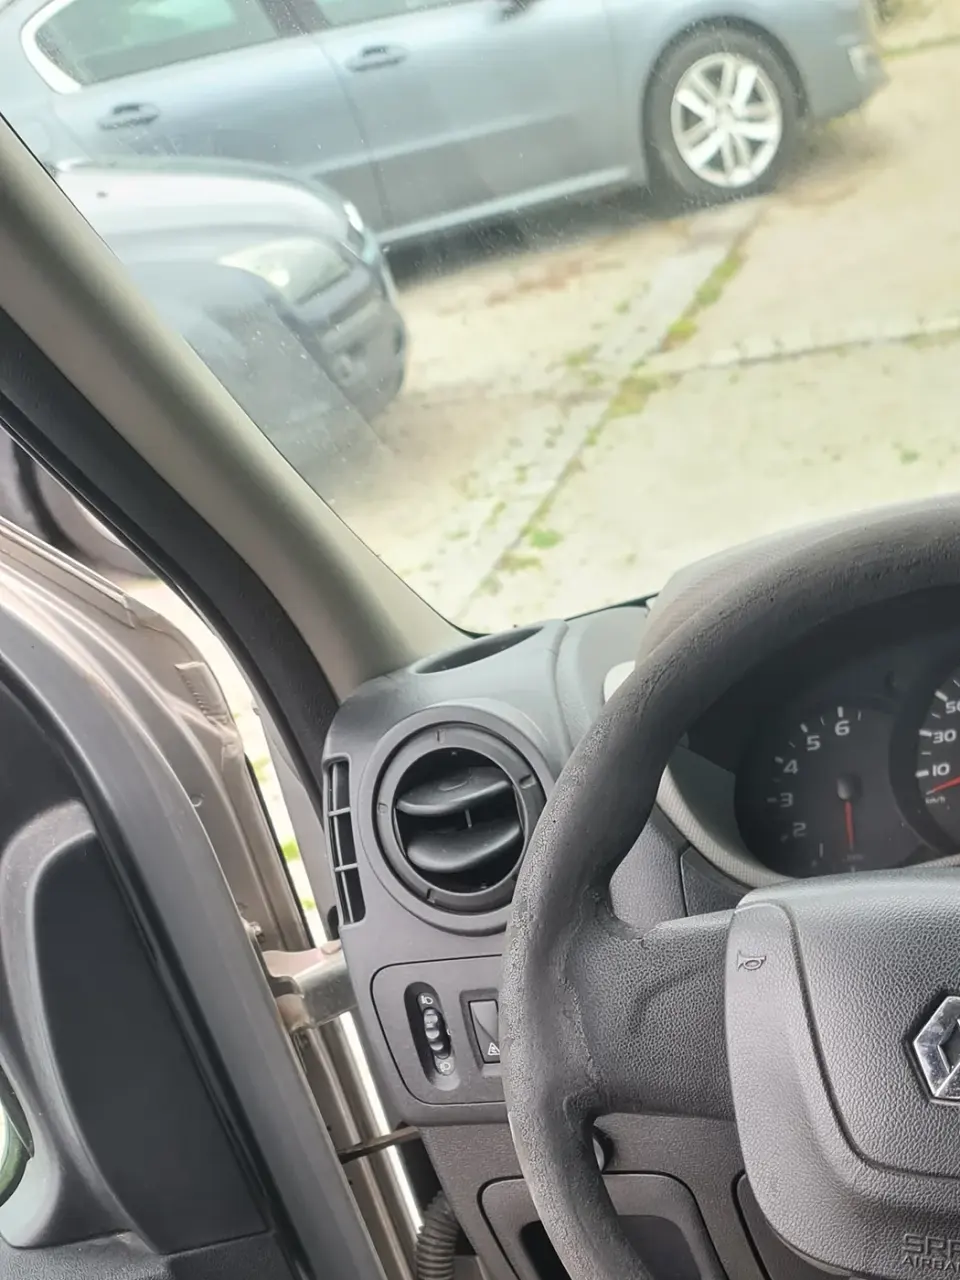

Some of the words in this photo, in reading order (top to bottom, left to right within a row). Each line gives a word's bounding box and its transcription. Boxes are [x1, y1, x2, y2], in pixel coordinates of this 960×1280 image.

[834, 720, 851, 736] 6
[806, 735, 821, 751] 5
[933, 729, 957, 744] 30
[783, 759, 798, 774] 4
[932, 762, 951, 777] 10
[780, 793, 793, 807] 3
[792, 822, 807, 838] 2
